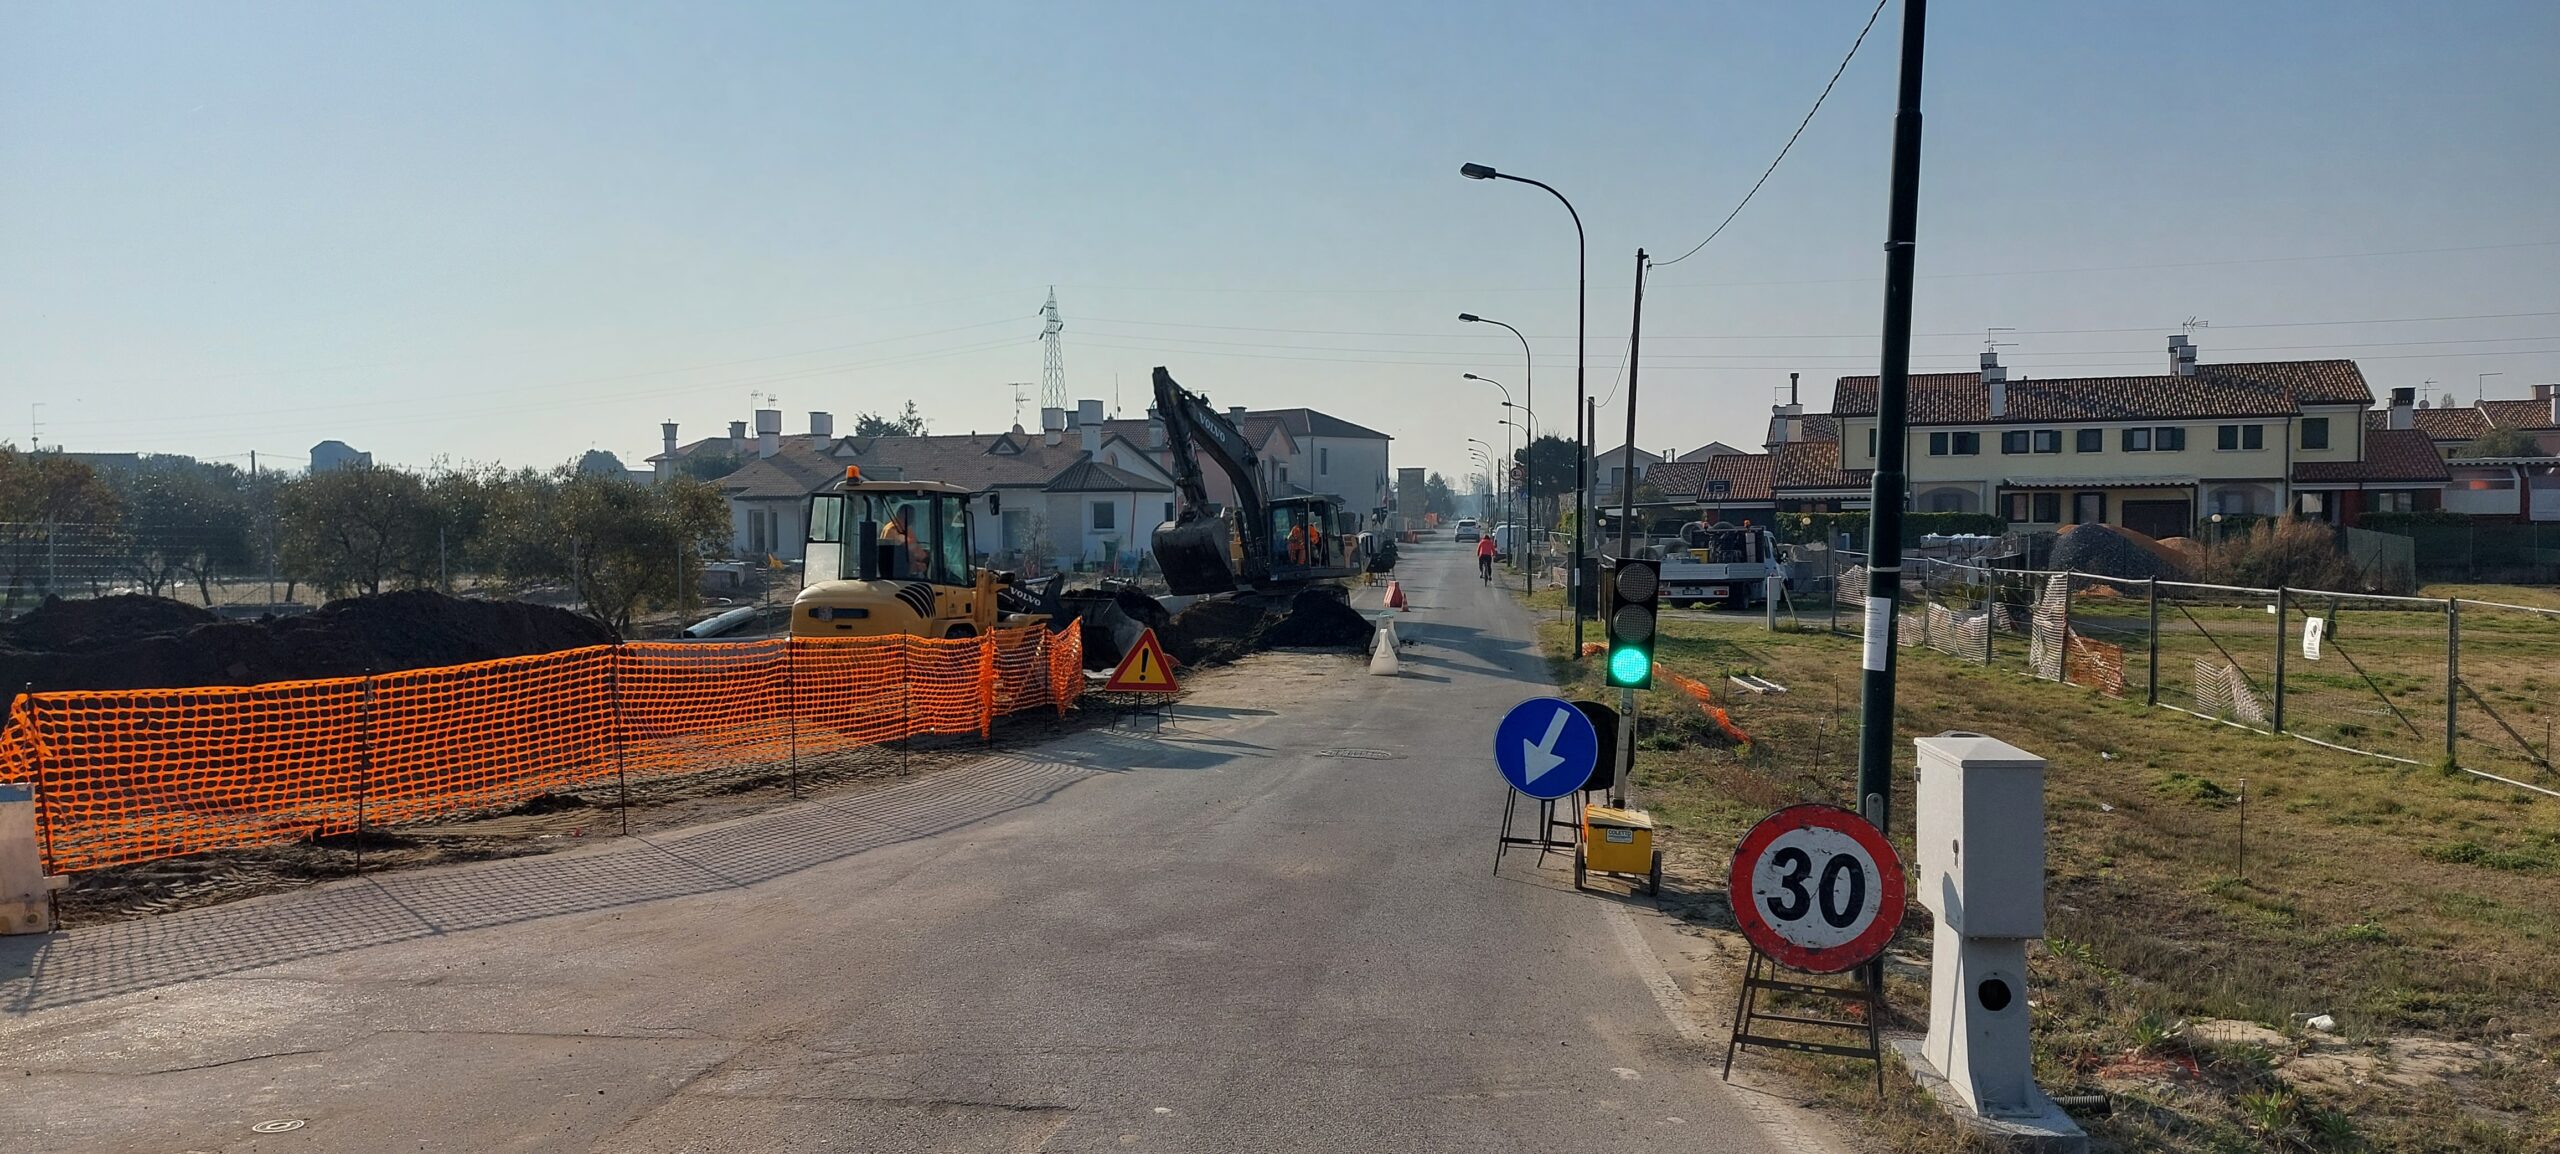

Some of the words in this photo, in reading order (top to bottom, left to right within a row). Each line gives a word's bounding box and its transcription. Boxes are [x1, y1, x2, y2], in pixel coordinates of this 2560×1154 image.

[1199, 412, 1226, 442] VOLVO
[1010, 586, 1041, 606] VOLVO
[1767, 847, 1866, 928] 30
